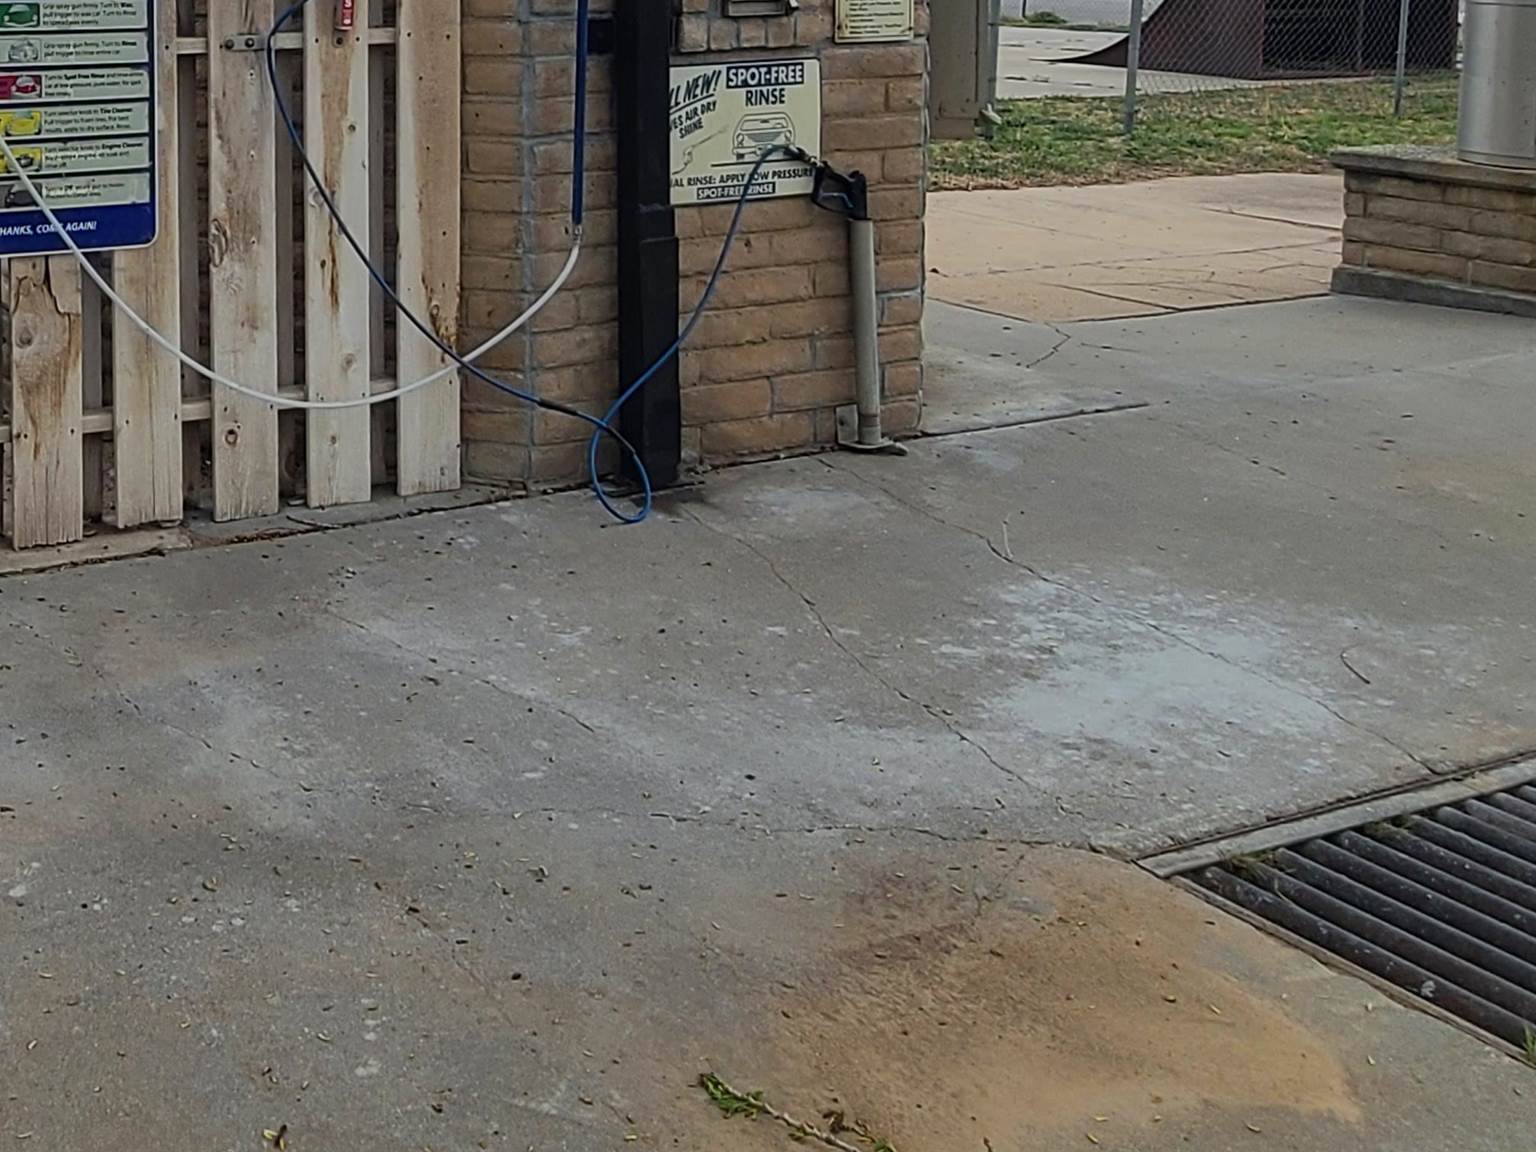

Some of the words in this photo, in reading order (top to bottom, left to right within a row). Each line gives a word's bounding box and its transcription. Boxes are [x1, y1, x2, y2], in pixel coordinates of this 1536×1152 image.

[728, 65, 804, 87] SPOT-FREE
[669, 85, 681, 108] LL
[683, 70, 722, 103] NEW!
[745, 88, 785, 106] RINSE
[700, 100, 717, 115] DRY
[679, 117, 704, 139] SHINE
[687, 175, 716, 187] RINSE:
[718, 173, 746, 184] APPLY
[749, 170, 770, 181] OW
[66, 221, 97, 232] AGAIN!
